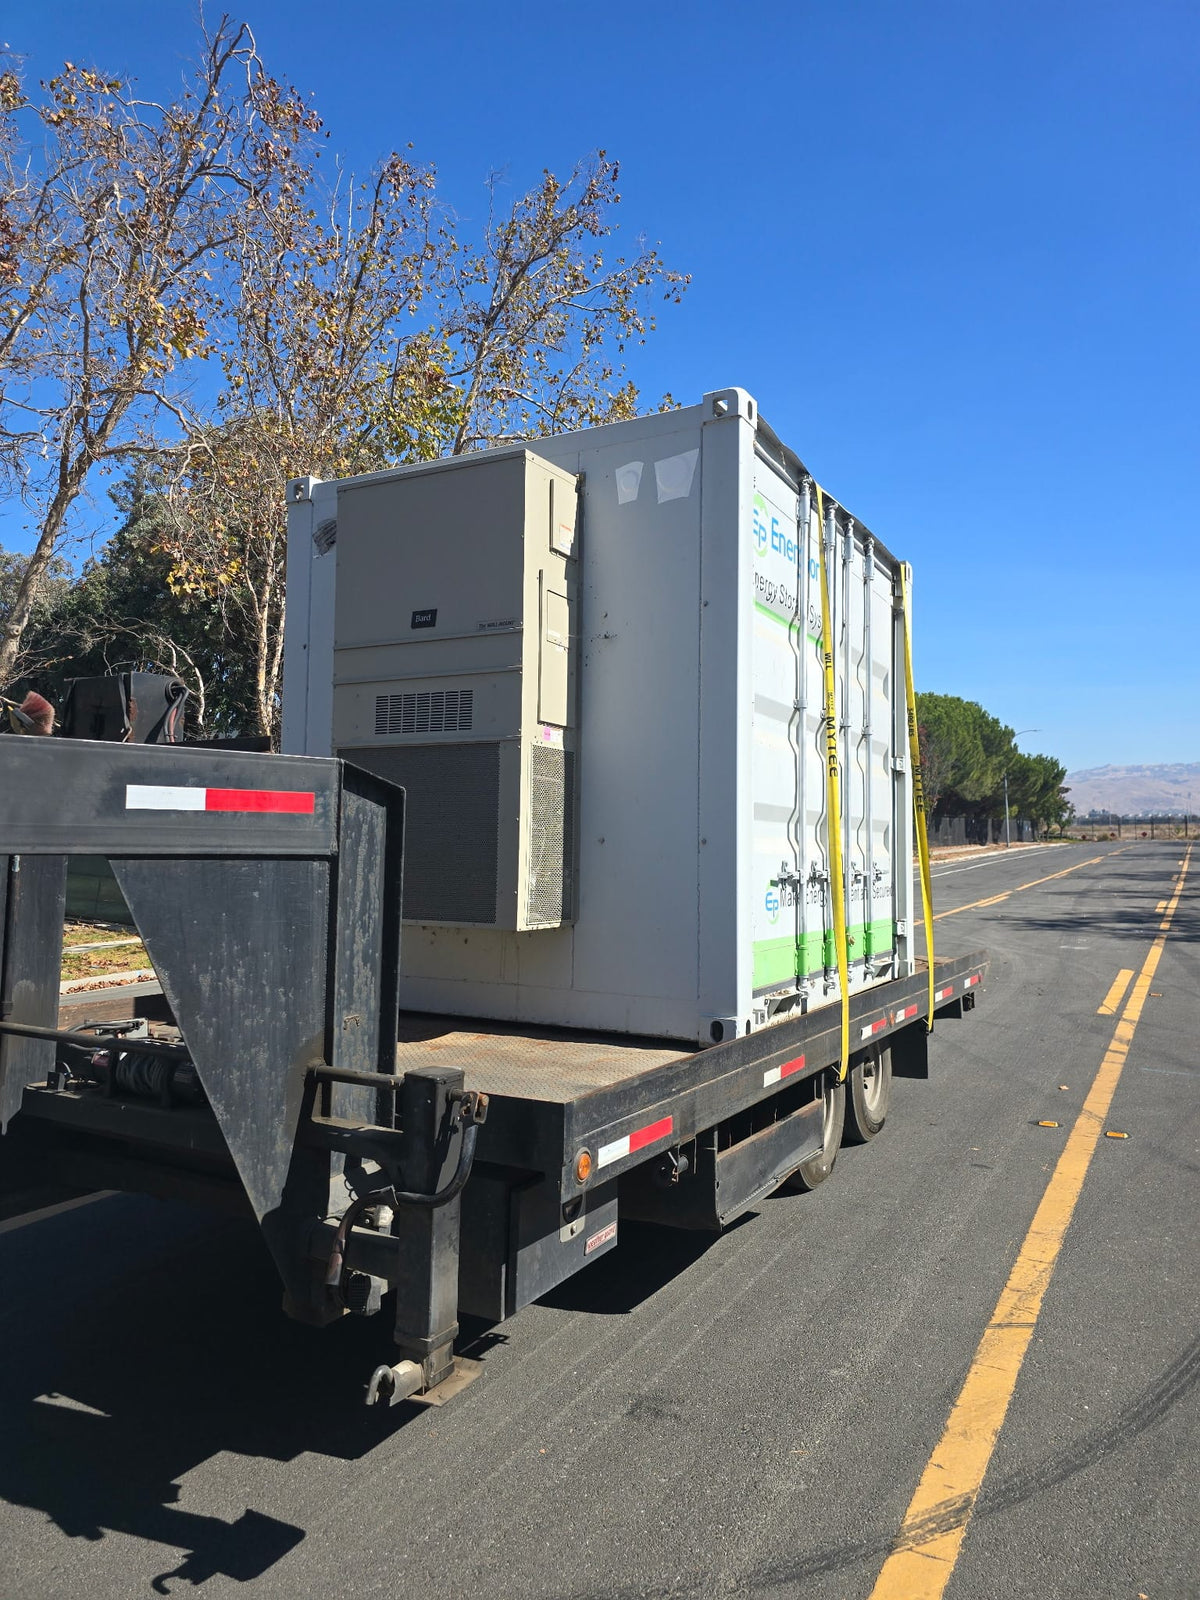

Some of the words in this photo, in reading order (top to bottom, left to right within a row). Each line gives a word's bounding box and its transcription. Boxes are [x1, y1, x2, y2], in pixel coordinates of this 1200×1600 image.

[771, 516, 820, 582] Eneror
[753, 568, 778, 604] nergy
[415, 614, 431, 623] Bard
[826, 716, 838, 777] MYTEE
